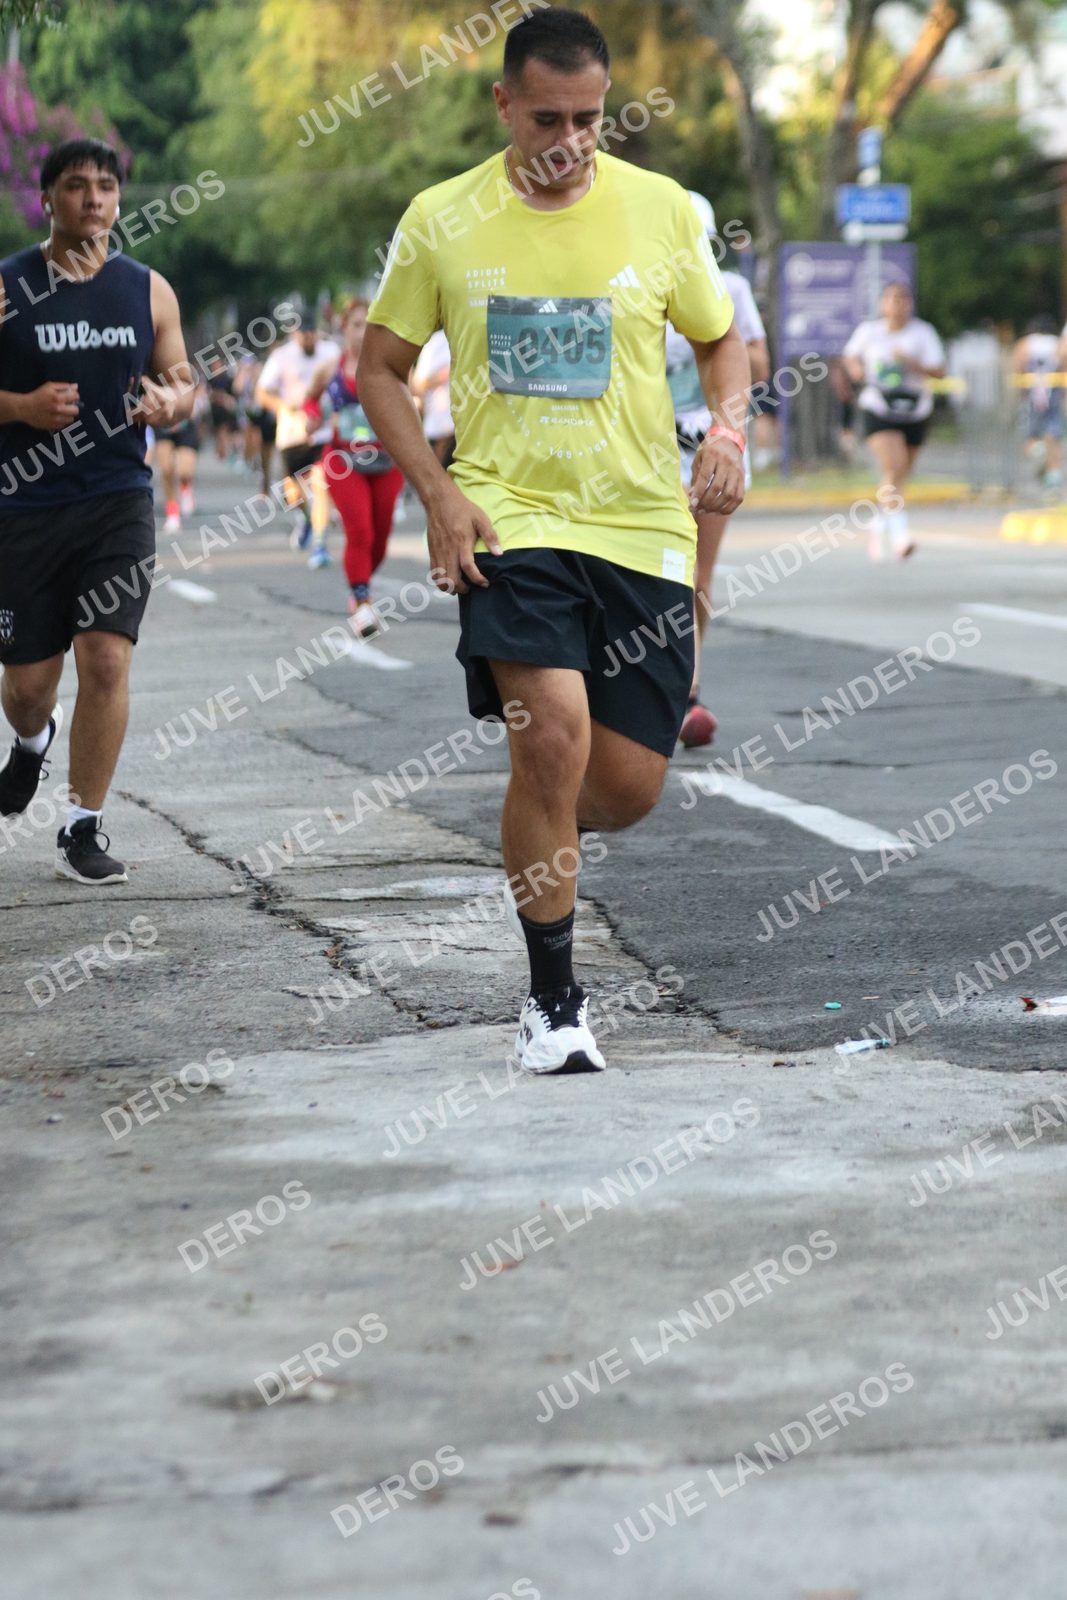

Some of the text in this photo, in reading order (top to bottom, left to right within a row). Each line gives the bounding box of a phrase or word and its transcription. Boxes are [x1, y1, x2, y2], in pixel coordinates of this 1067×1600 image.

[465, 266, 506, 279] ADIDAS
[467, 277, 505, 289] SPLITS
[35, 320, 137, 352] Wilson
[528, 383, 568, 392] SAMSUNG
